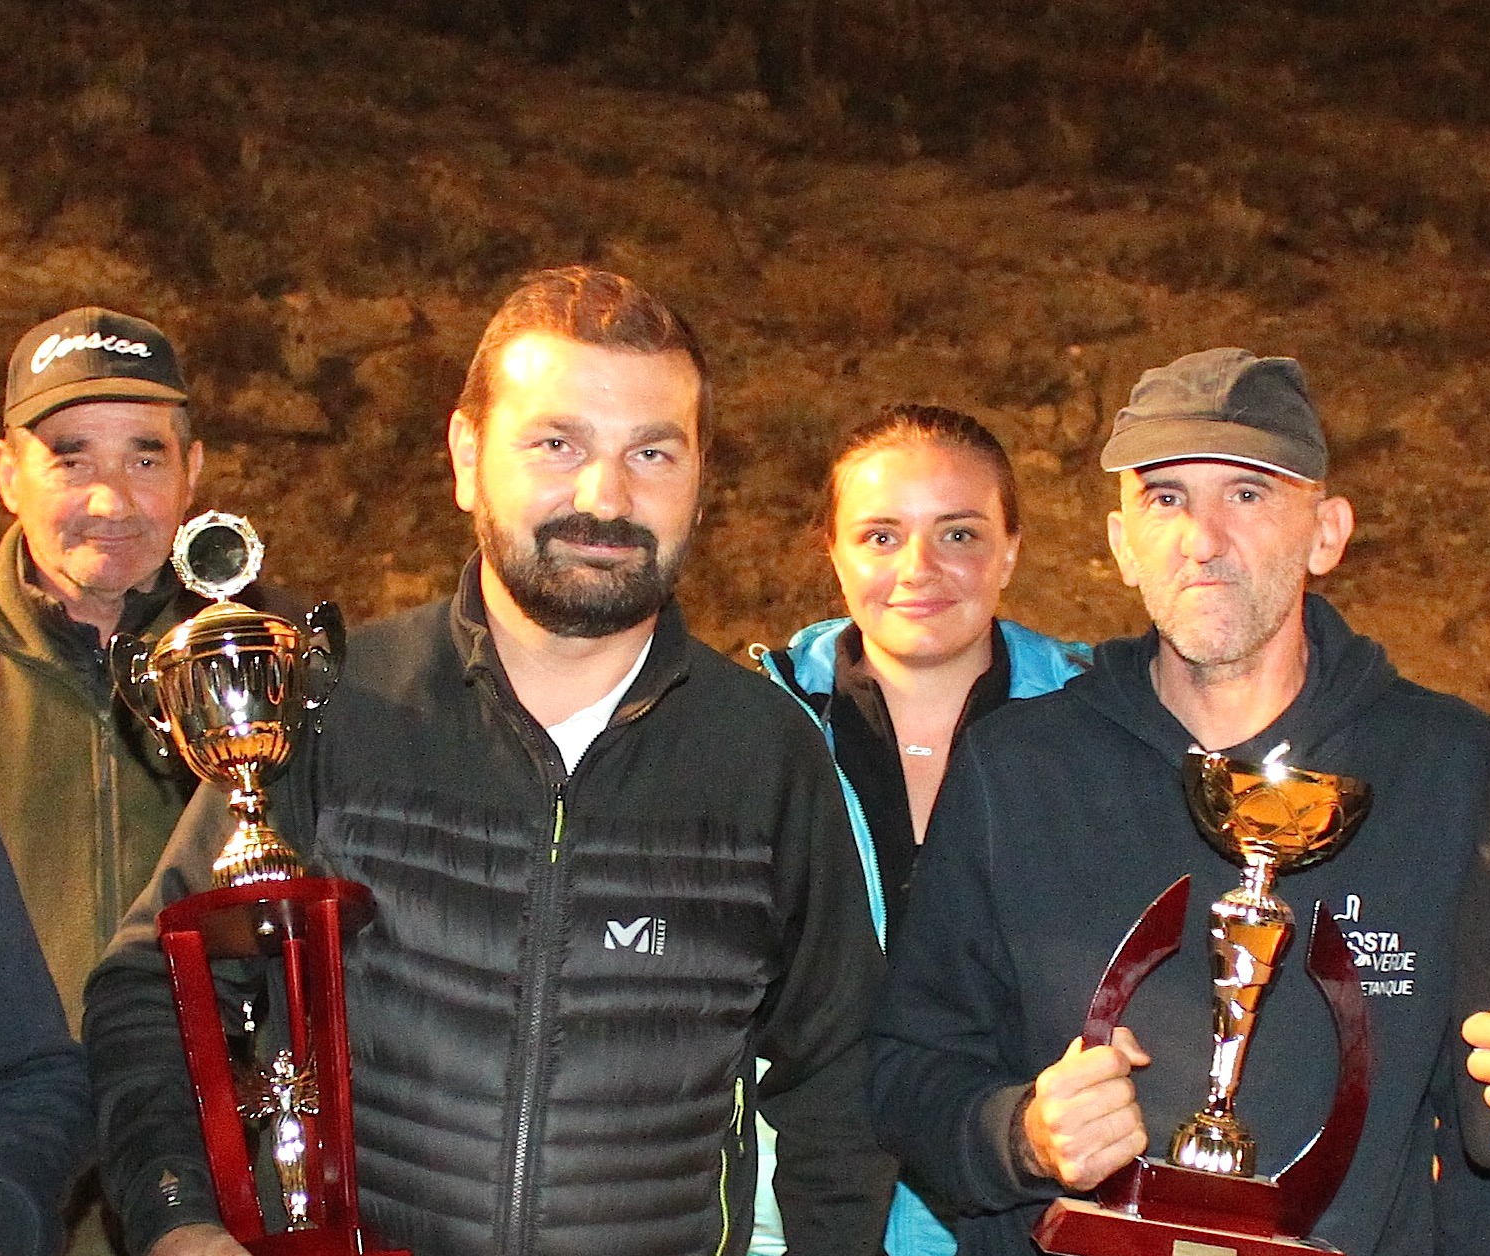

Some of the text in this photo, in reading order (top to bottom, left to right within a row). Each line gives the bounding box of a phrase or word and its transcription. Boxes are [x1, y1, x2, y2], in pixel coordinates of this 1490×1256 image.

[655, 917, 667, 956] MILLET
[1342, 931, 1400, 953] OSTA
[1371, 951, 1417, 972] VERDE
[1360, 979, 1415, 997] ETANQUE
